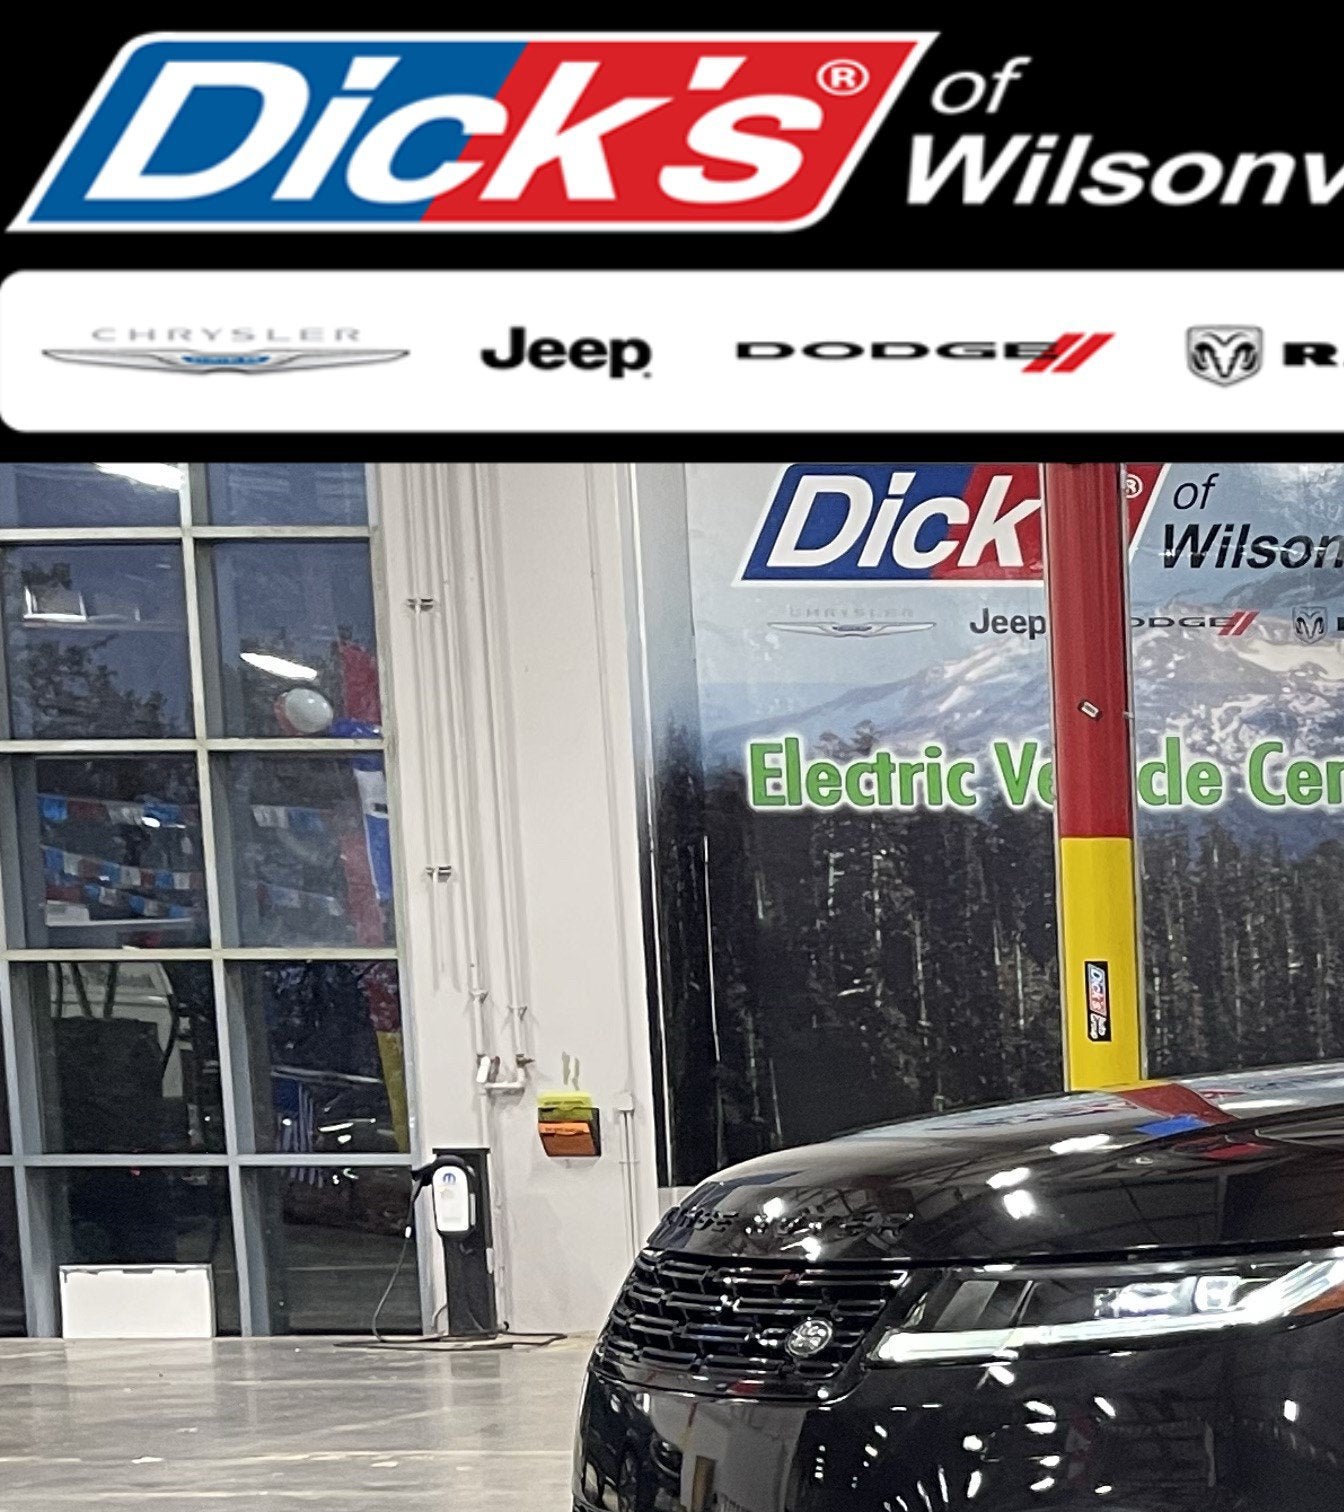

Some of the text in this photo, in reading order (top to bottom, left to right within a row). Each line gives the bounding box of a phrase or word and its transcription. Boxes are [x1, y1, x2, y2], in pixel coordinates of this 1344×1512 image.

[1173, 472, 1220, 510] of
[766, 471, 1043, 570] Dick
[969, 607, 1047, 640] Jeep
[1131, 615, 1237, 629] DGE
[749, 737, 977, 807] Electric
[993, 736, 1223, 807] Vcle
